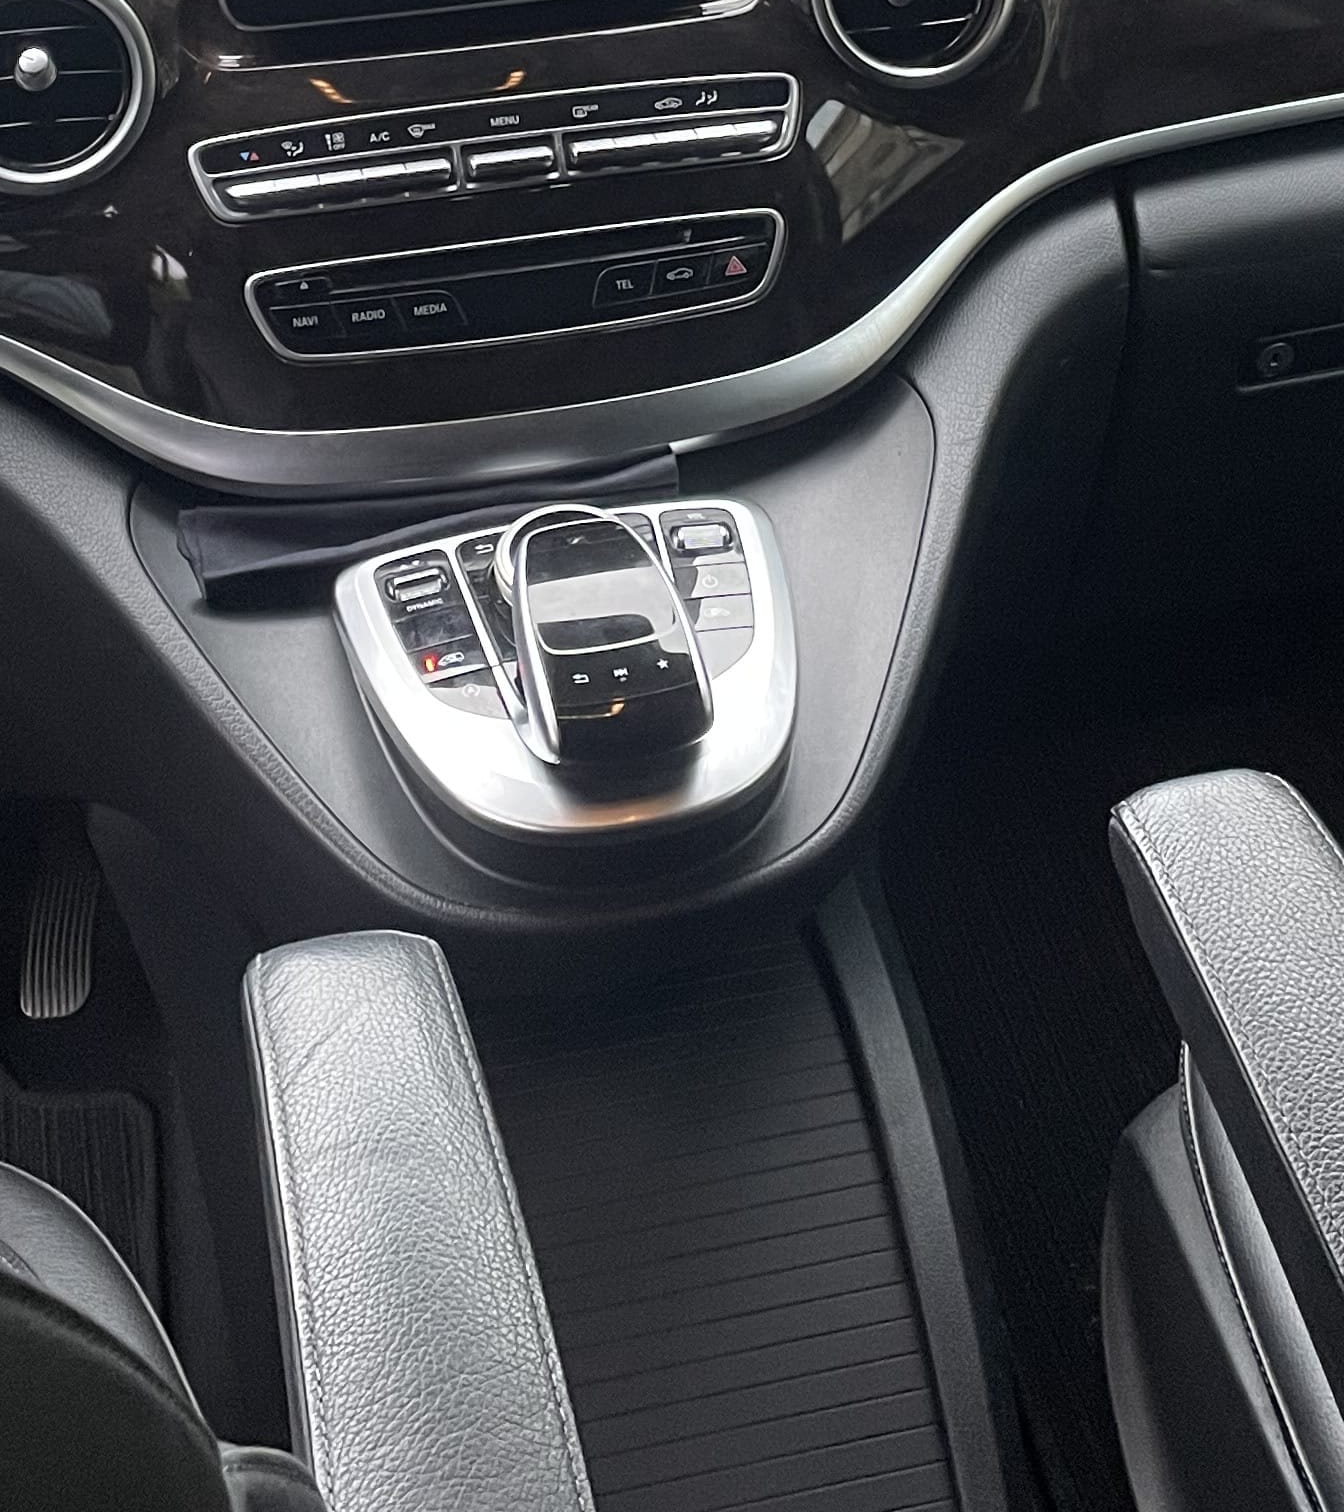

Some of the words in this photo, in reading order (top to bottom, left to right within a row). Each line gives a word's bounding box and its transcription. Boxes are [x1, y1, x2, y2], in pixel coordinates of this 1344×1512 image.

[489, 114, 521, 128] MENU
[369, 131, 391, 144] A/C
[615, 279, 635, 291] TEL
[351, 309, 387, 323] RADIO
[413, 302, 448, 317] MEDIA
[292, 315, 319, 328] NAVI
